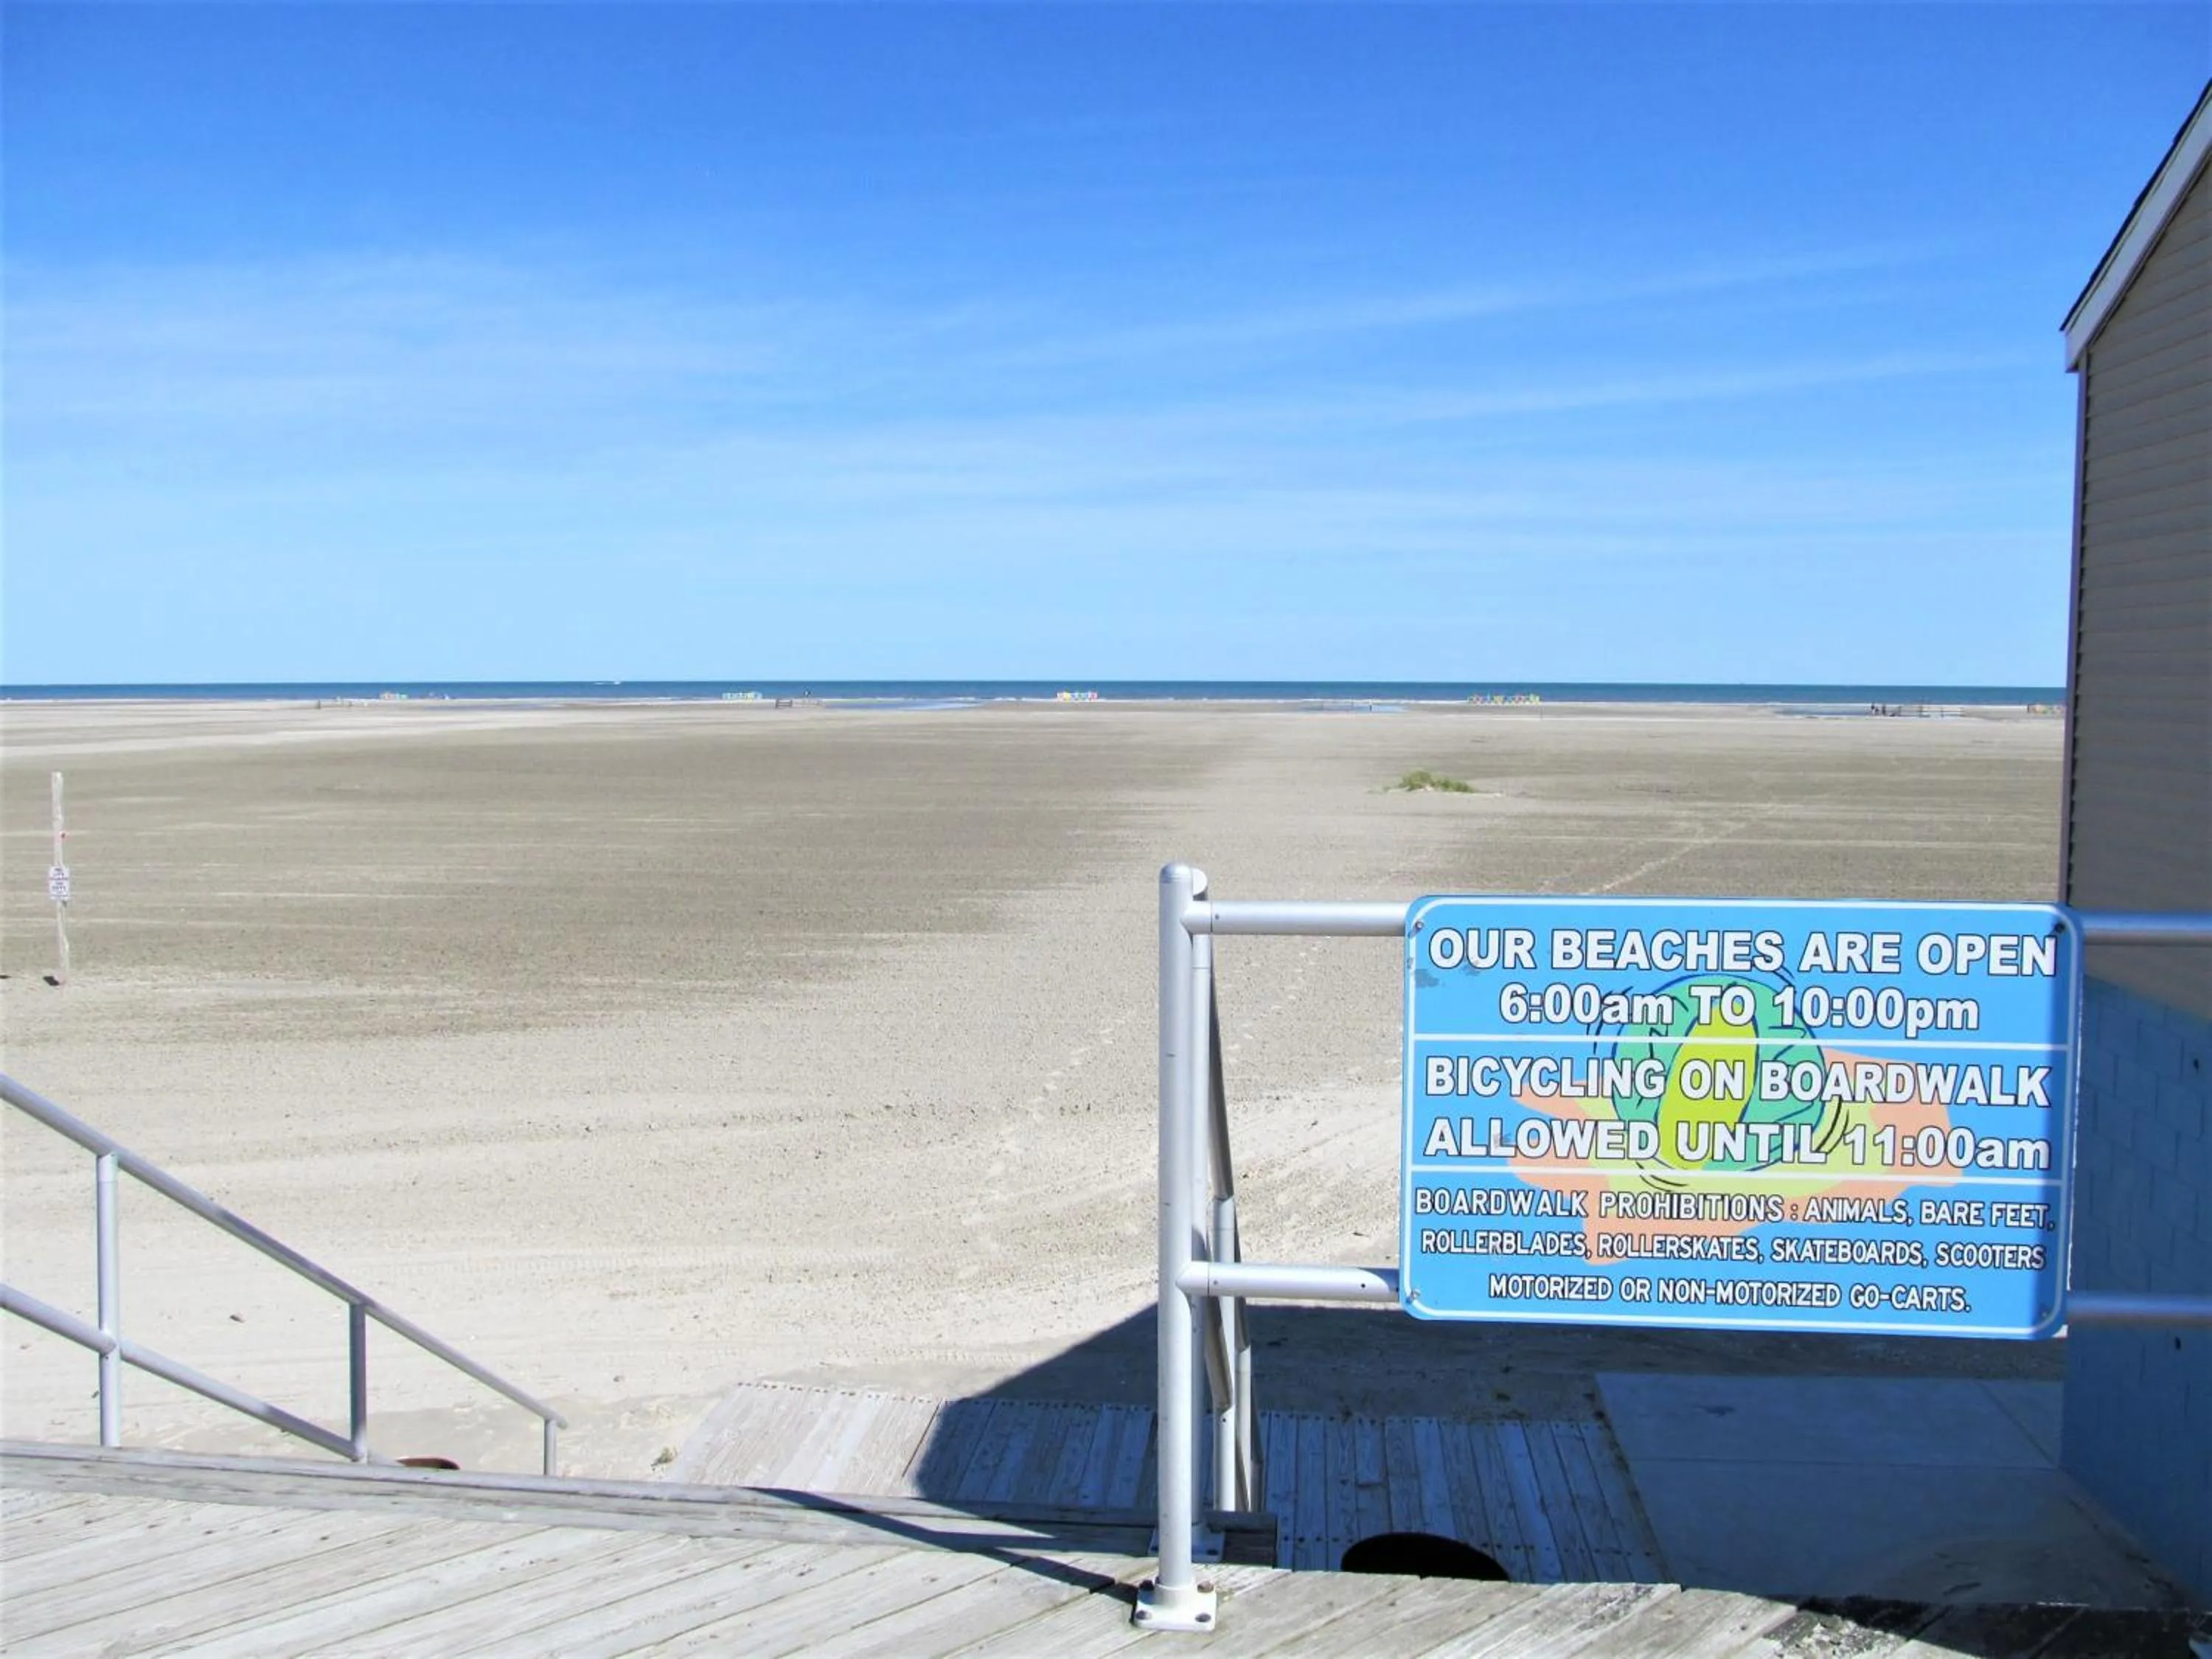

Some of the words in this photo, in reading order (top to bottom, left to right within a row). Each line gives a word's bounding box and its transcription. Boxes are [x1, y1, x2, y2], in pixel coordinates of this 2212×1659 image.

[1429, 928, 1536, 970] OUR
[1551, 930, 1784, 973] BEACHES
[1799, 933, 1902, 973] ARE
[1917, 935, 2057, 977] OPEN
[1500, 984, 1673, 1024] 6:00am
[1689, 986, 1755, 1026] TO
[1773, 987, 1980, 1037] 10:00pm
[1425, 1056, 1667, 1099] BICYCLING
[1680, 1060, 1746, 1101] ON
[1759, 1061, 2051, 1107] BOARDWALK
[1423, 1117, 1660, 1161] ALLOWED
[1676, 1121, 1827, 1164] UNTIL
[1843, 1127, 2051, 1169] 11:00am
[1415, 1188, 1588, 1217] BOARDWALK
[1803, 1197, 1914, 1226] ANIMALS,
[1920, 1200, 1984, 1226] BARE
[1989, 1202, 2055, 1231] FEET,
[1421, 1228, 1593, 1259] ROLLERBLADES,
[1597, 1234, 1764, 1263] ROLLERSKATES,
[1771, 1238, 1928, 1267] SKATEBOARDS,
[1935, 1242, 2046, 1269] SCOOTERS
[1489, 1273, 1613, 1301] MOTORIZED
[1619, 1277, 1652, 1302] OR
[1658, 1279, 1841, 1308] NON-MOTORIZED
[1849, 1284, 1972, 1312] GO-CARTS.
